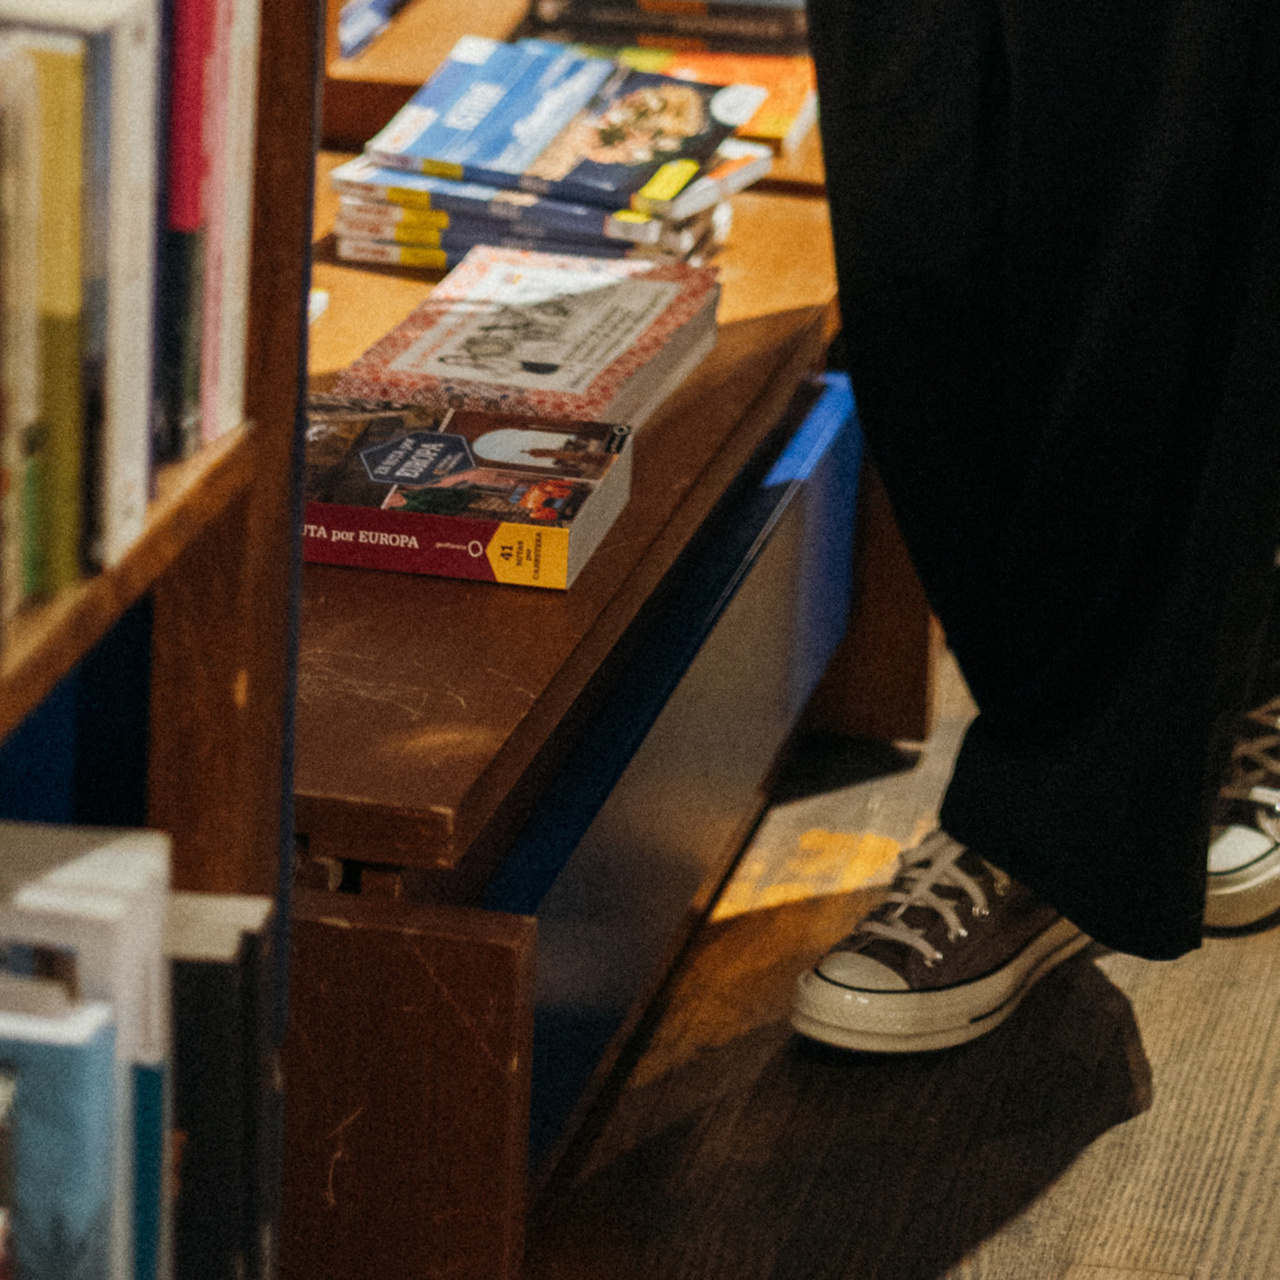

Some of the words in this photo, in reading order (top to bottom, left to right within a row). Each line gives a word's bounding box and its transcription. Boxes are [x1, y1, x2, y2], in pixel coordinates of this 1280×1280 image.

[394, 442, 445, 479] EUROPA
[331, 529, 355, 543] por
[358, 530, 420, 550] EUROPA
[500, 544, 514, 561] 41
